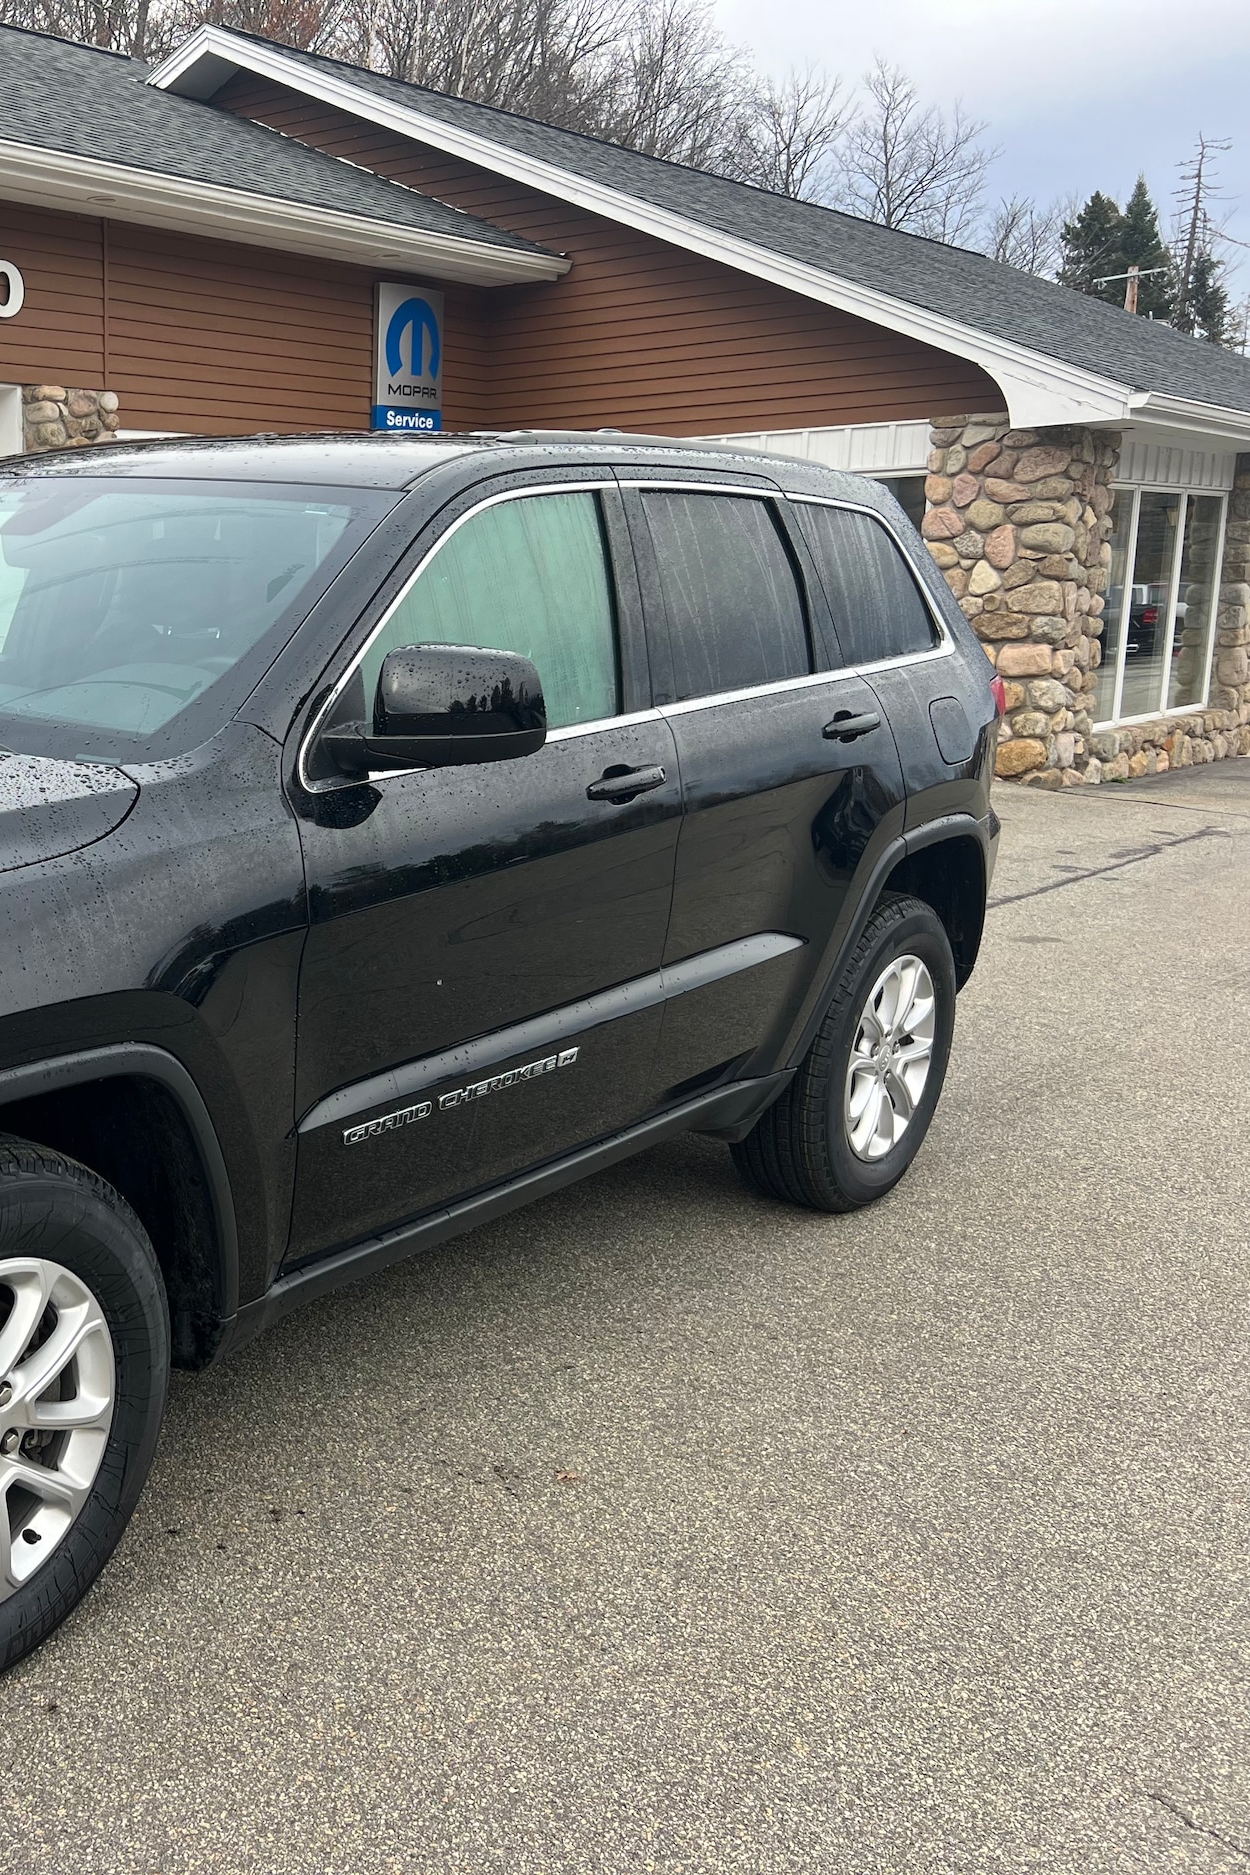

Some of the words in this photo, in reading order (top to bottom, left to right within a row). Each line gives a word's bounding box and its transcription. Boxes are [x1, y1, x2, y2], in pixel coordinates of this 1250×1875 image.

[387, 383, 437, 399] MOPAR
[386, 410, 434, 430] Service
[343, 1101, 433, 1146] GRAND
[438, 1054, 558, 1111] CHEROKEE
